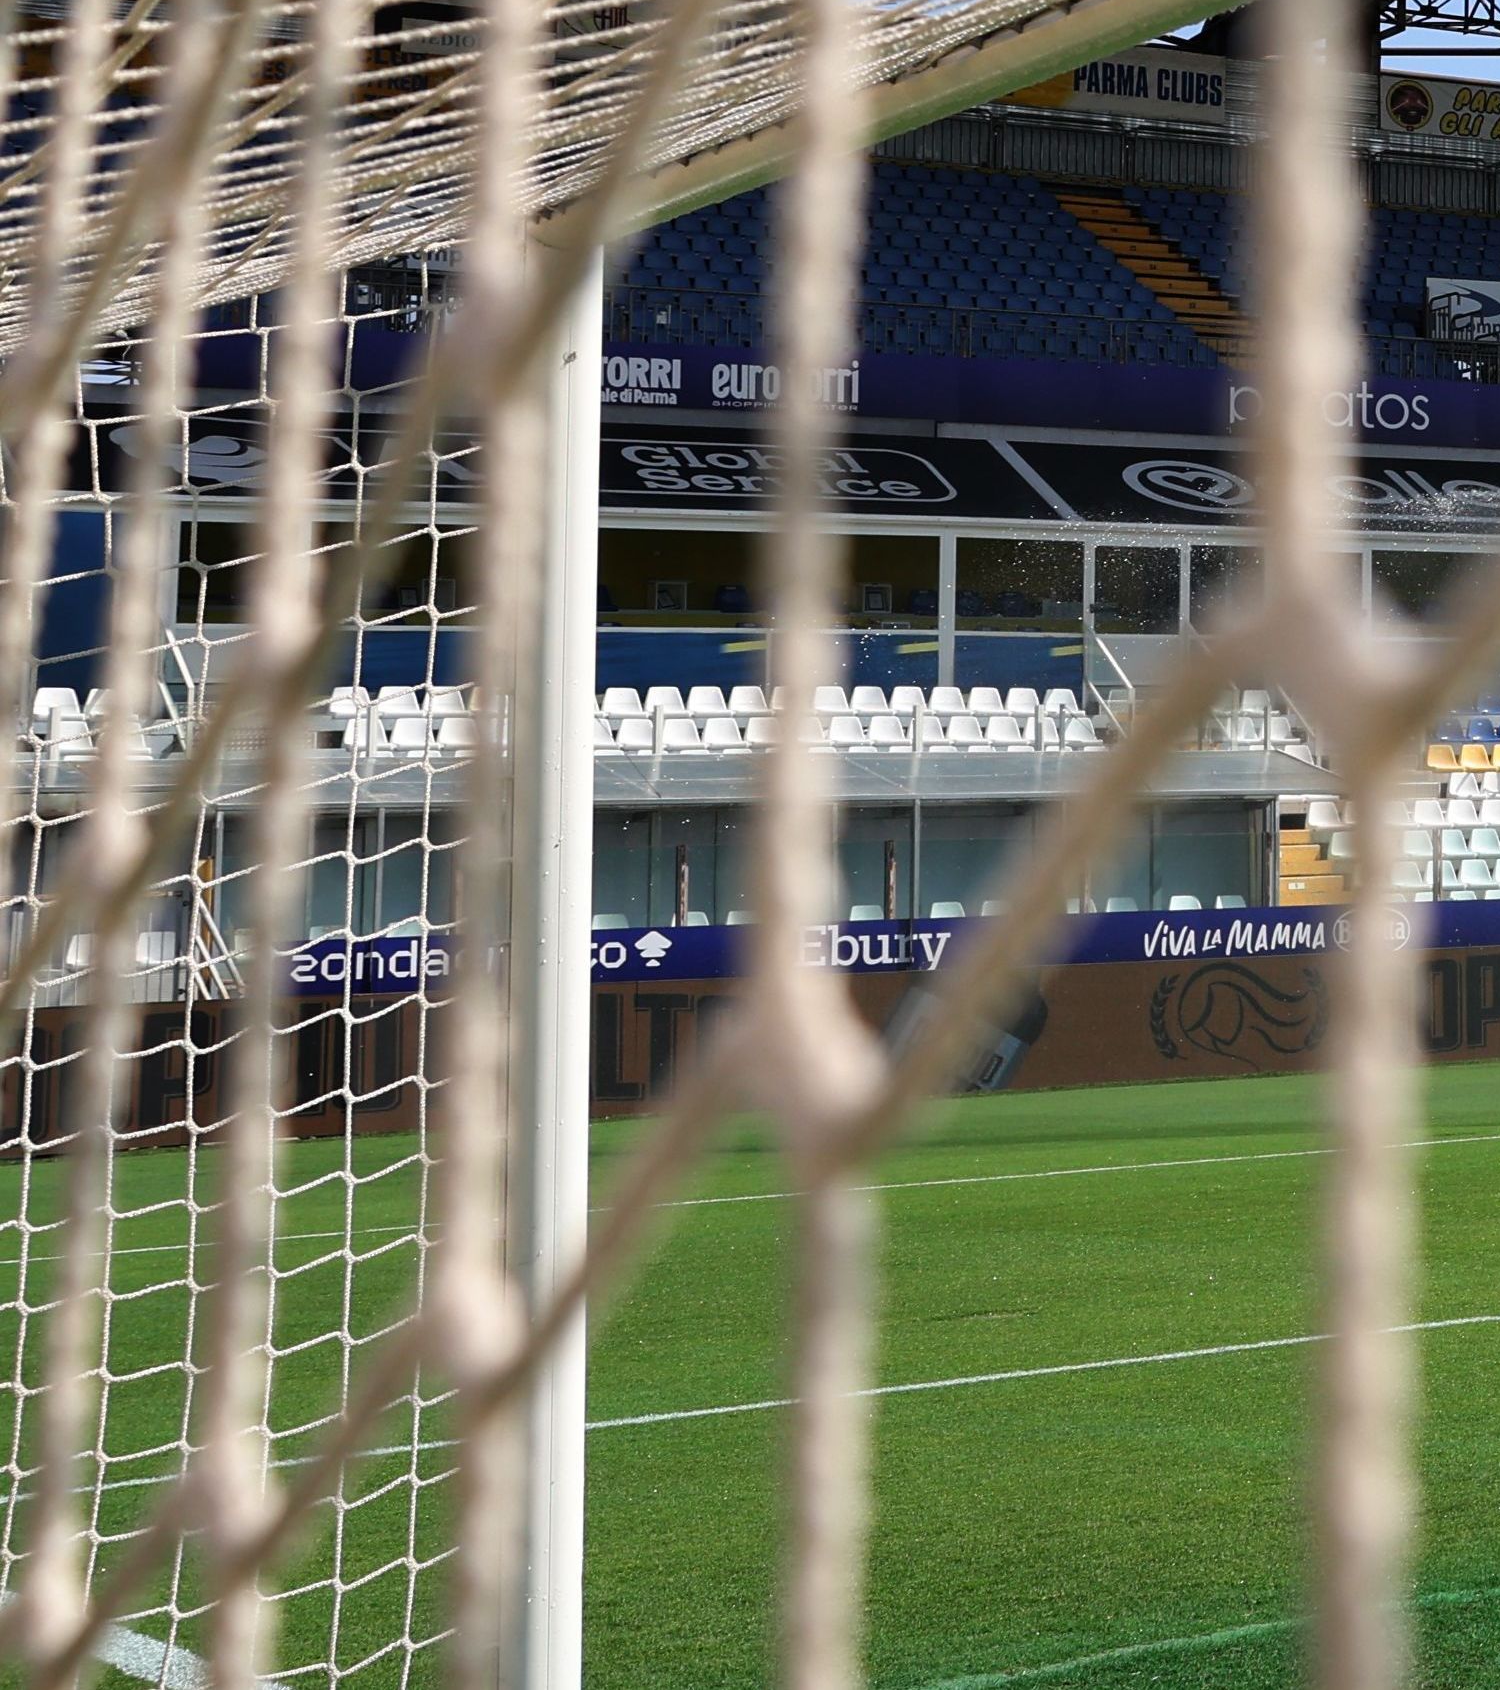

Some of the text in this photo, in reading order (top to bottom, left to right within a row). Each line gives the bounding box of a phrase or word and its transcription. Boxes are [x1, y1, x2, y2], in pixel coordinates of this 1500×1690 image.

[1073, 63, 1223, 107] PARMA CLUBS
[1440, 110, 1483, 137] GLI
[634, 388, 678, 405] Parma
[1225, 918, 1326, 956] MAMMA
